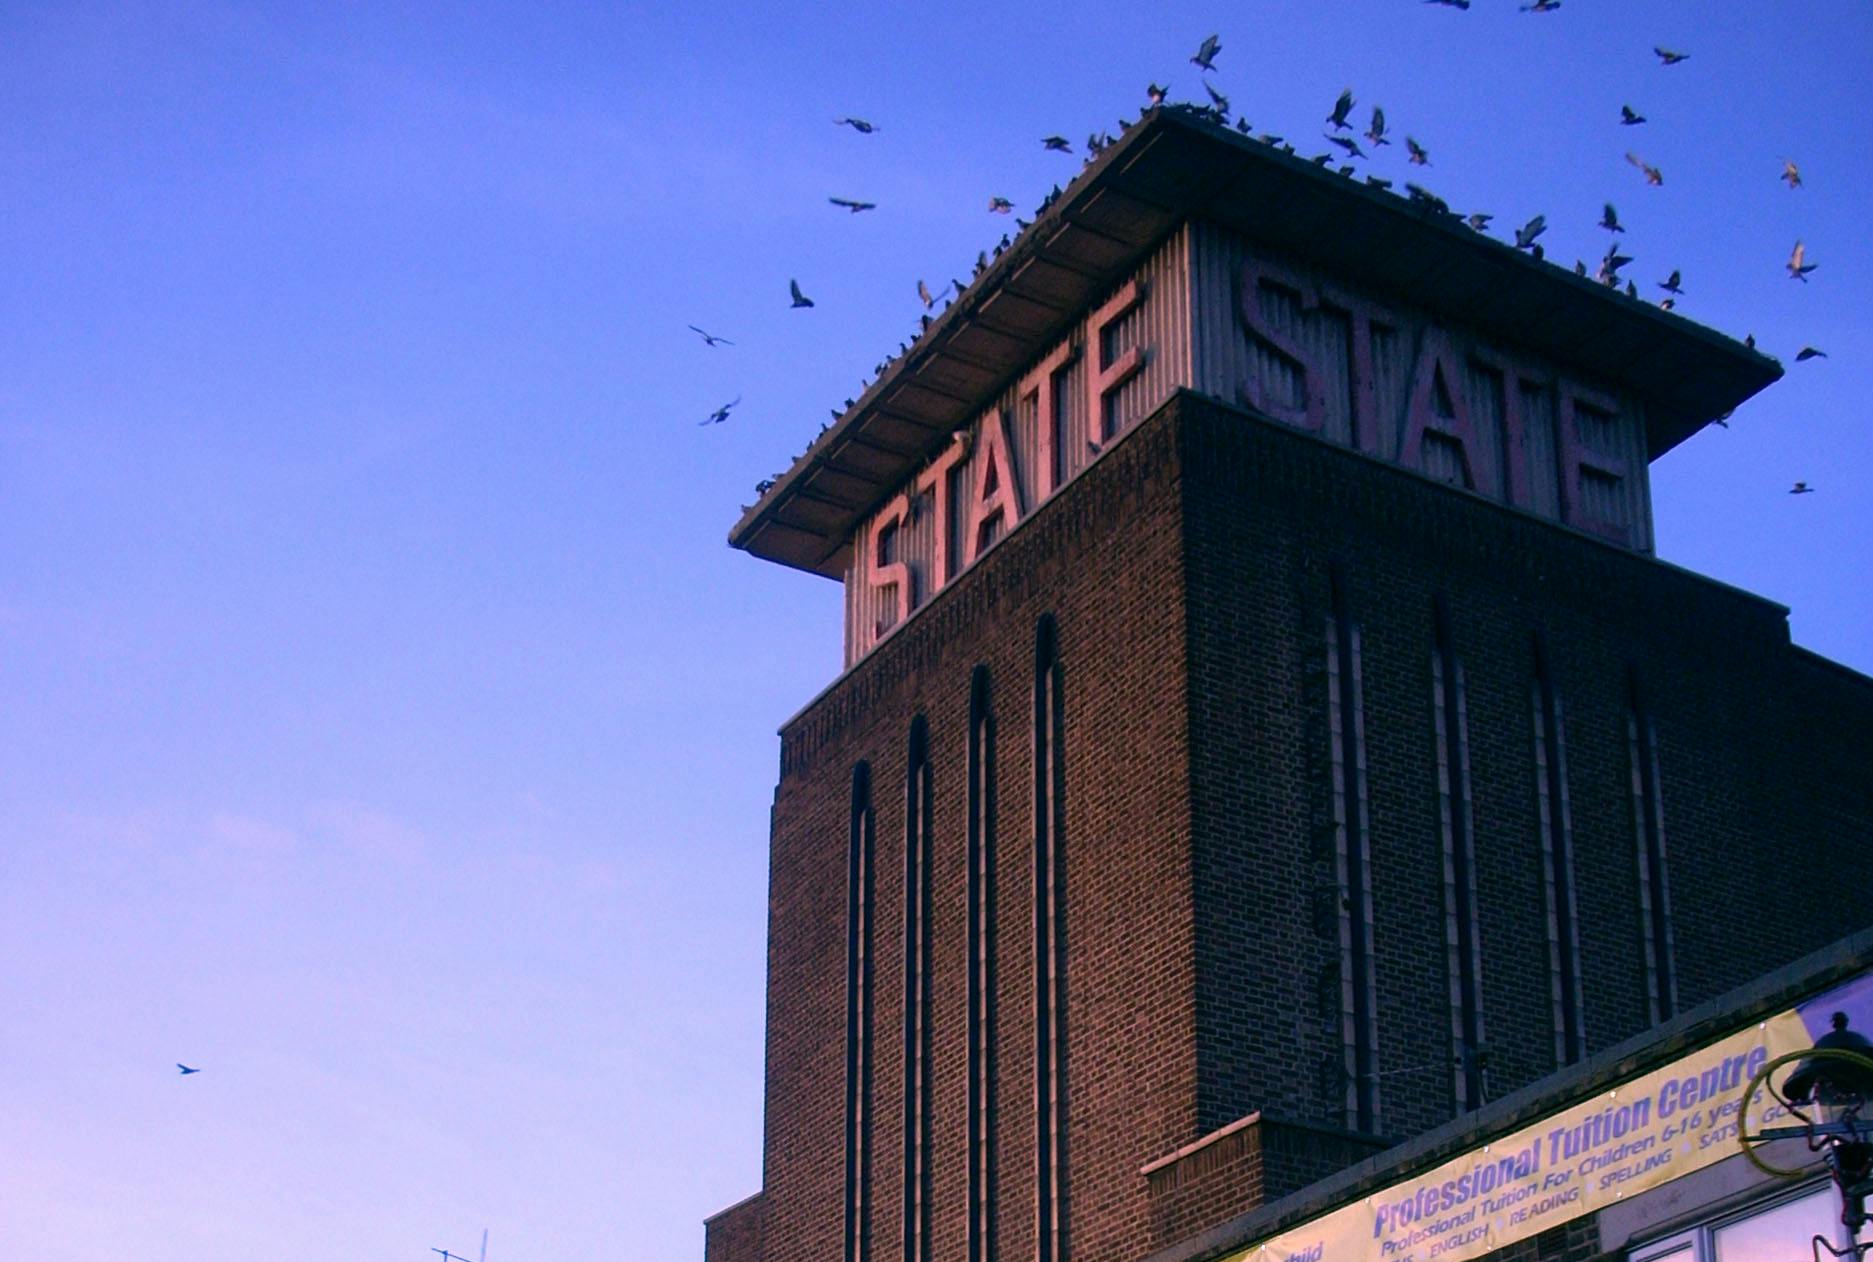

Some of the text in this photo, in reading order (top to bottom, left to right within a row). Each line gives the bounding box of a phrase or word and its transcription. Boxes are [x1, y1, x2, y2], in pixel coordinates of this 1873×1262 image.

[868, 279, 1145, 640] STATE
[1238, 256, 1633, 546] STATE
[1373, 1045, 1768, 1239] Professional Tuition Centre
[1380, 1088, 1763, 1257] Professional Tuition For Children 6-16 yeas
[1429, 1223, 1490, 1259] ENGLISH
[1509, 1187, 1580, 1227] READING
[1599, 1149, 1673, 1191] SPELLING
[1699, 1123, 1740, 1150] SATS
